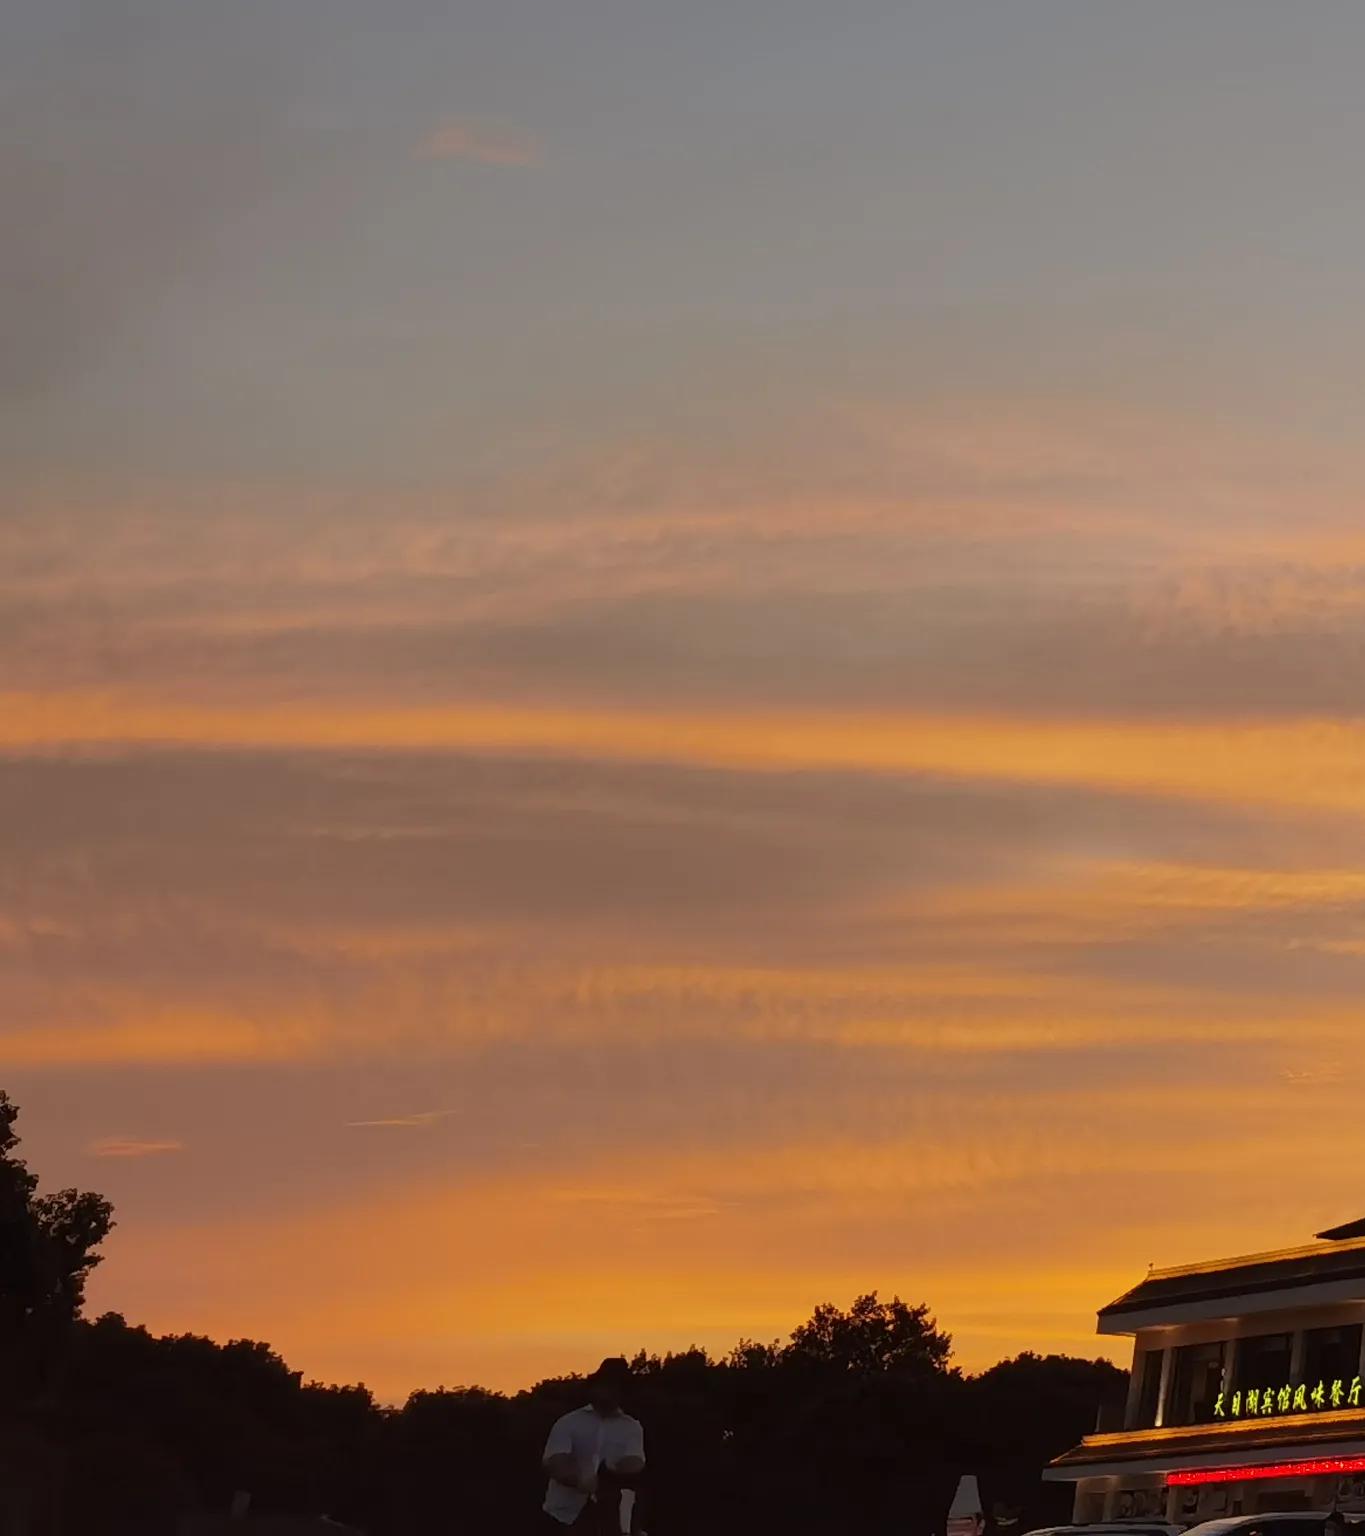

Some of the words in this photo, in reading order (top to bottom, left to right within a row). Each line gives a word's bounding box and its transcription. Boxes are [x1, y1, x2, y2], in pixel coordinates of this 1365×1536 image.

[1213, 1375, 1364, 1418] 天目湖宾馆风味餐厅
